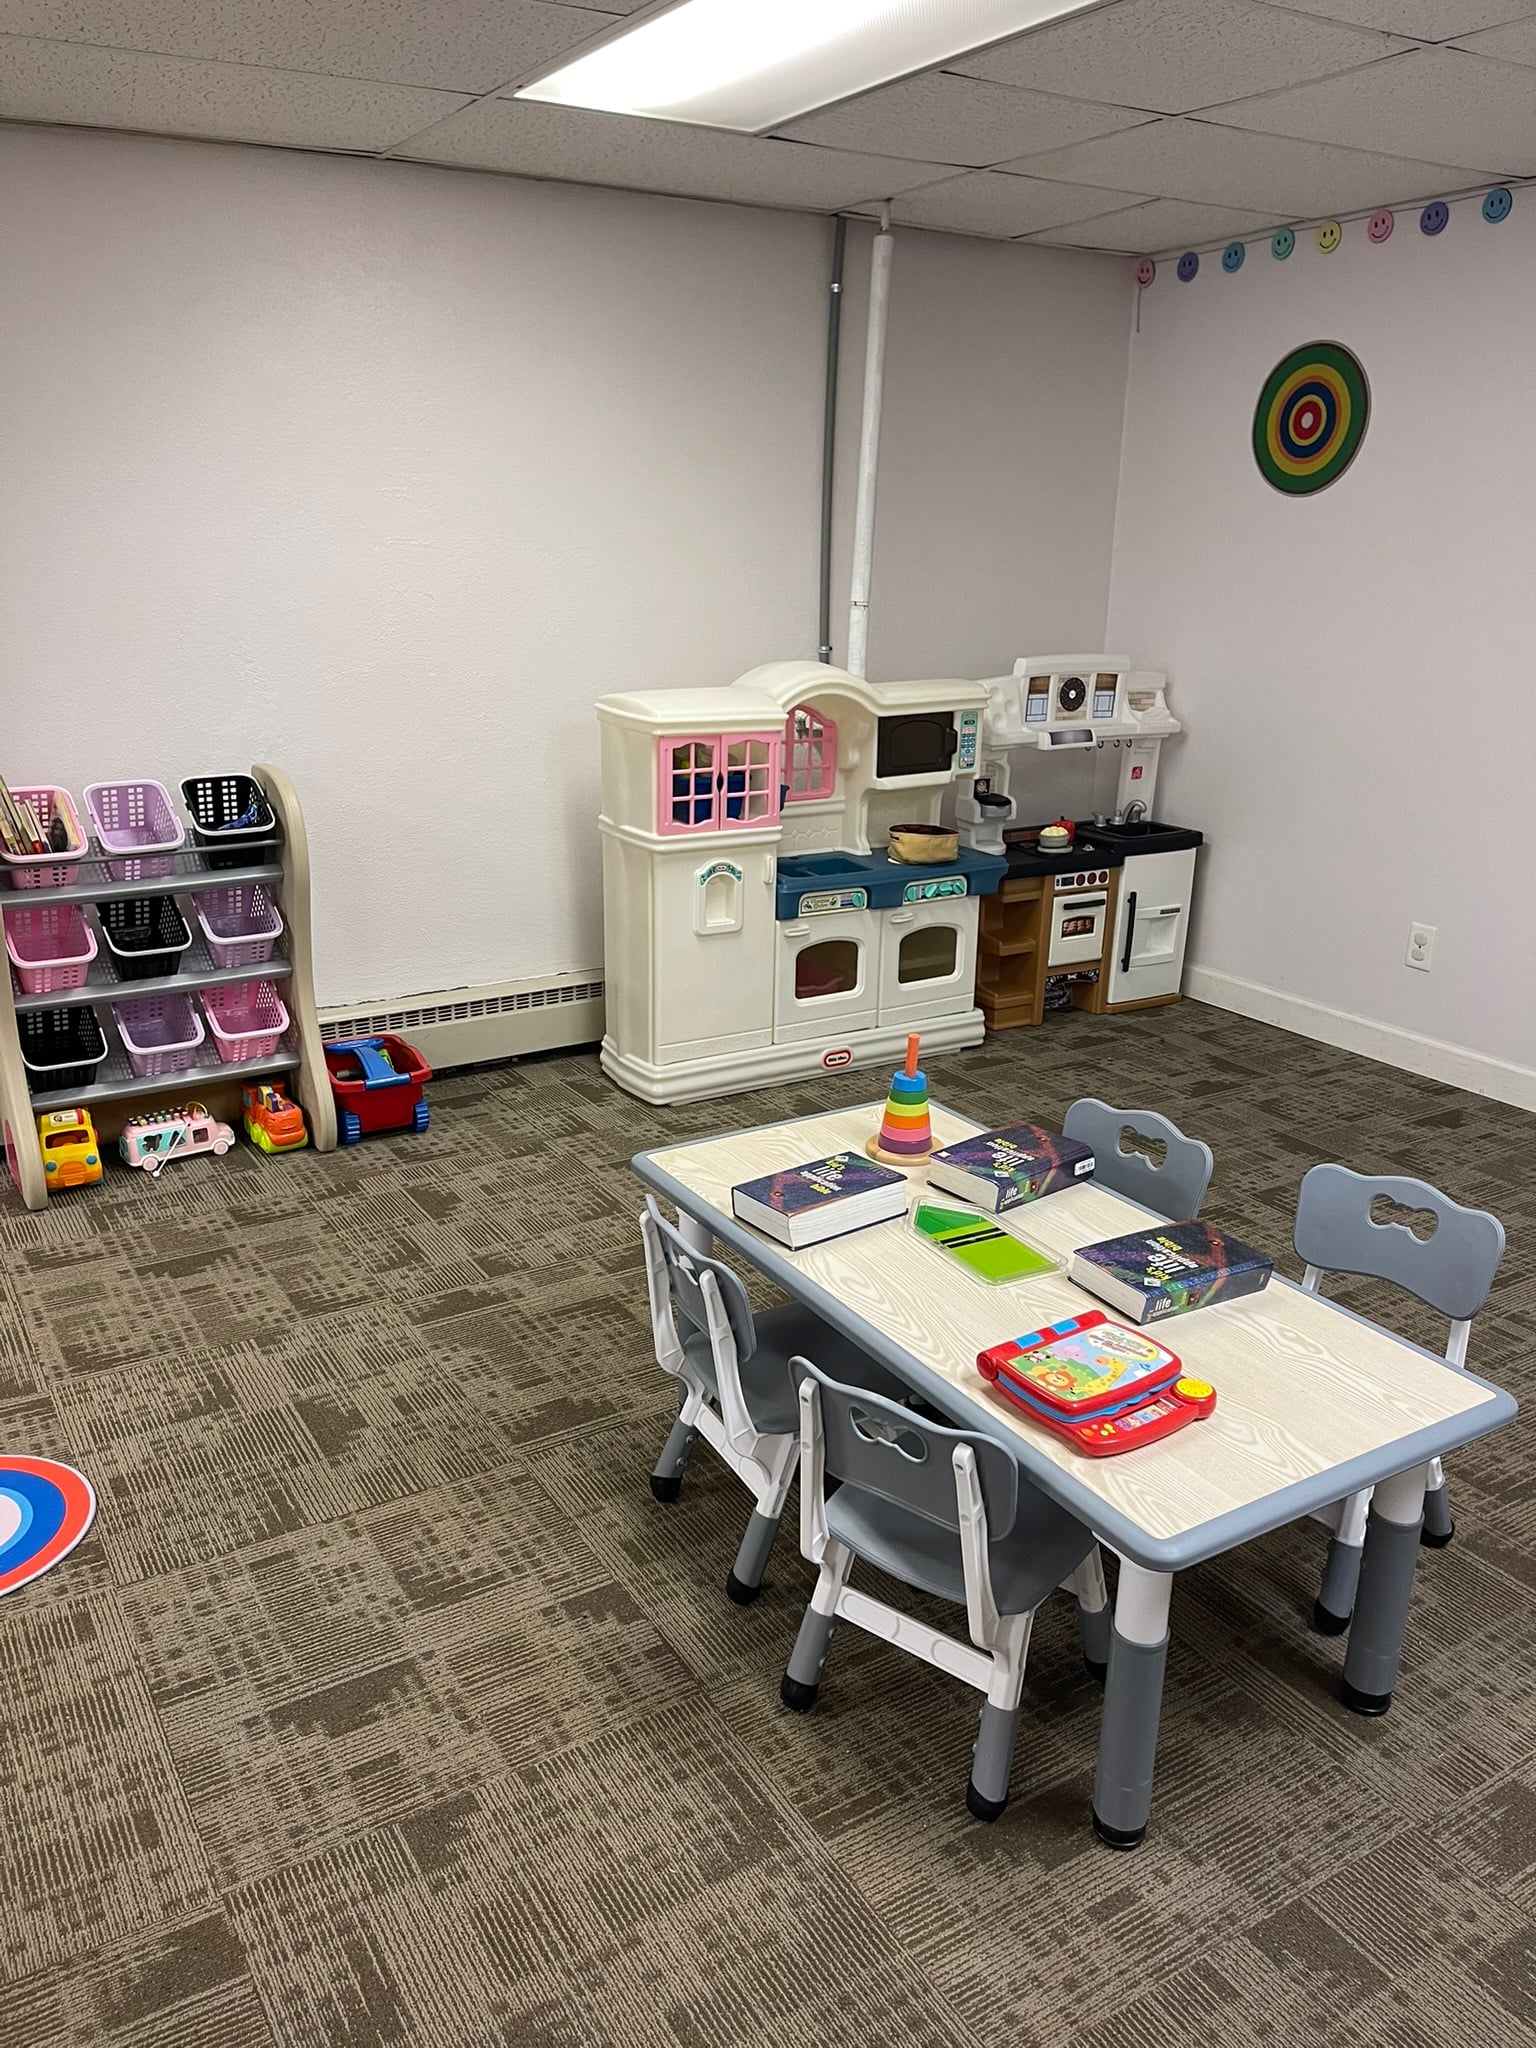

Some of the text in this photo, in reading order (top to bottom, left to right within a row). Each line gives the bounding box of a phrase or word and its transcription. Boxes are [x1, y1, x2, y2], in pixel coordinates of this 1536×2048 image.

[991, 1151, 1025, 1167] life
[811, 1165, 843, 1181] life
[1005, 1186, 1018, 1200] life
[1156, 1236, 1184, 1252] bible
[1146, 1253, 1186, 1274] life
[1145, 1266, 1173, 1281] kid's
[1154, 1297, 1172, 1312] life
